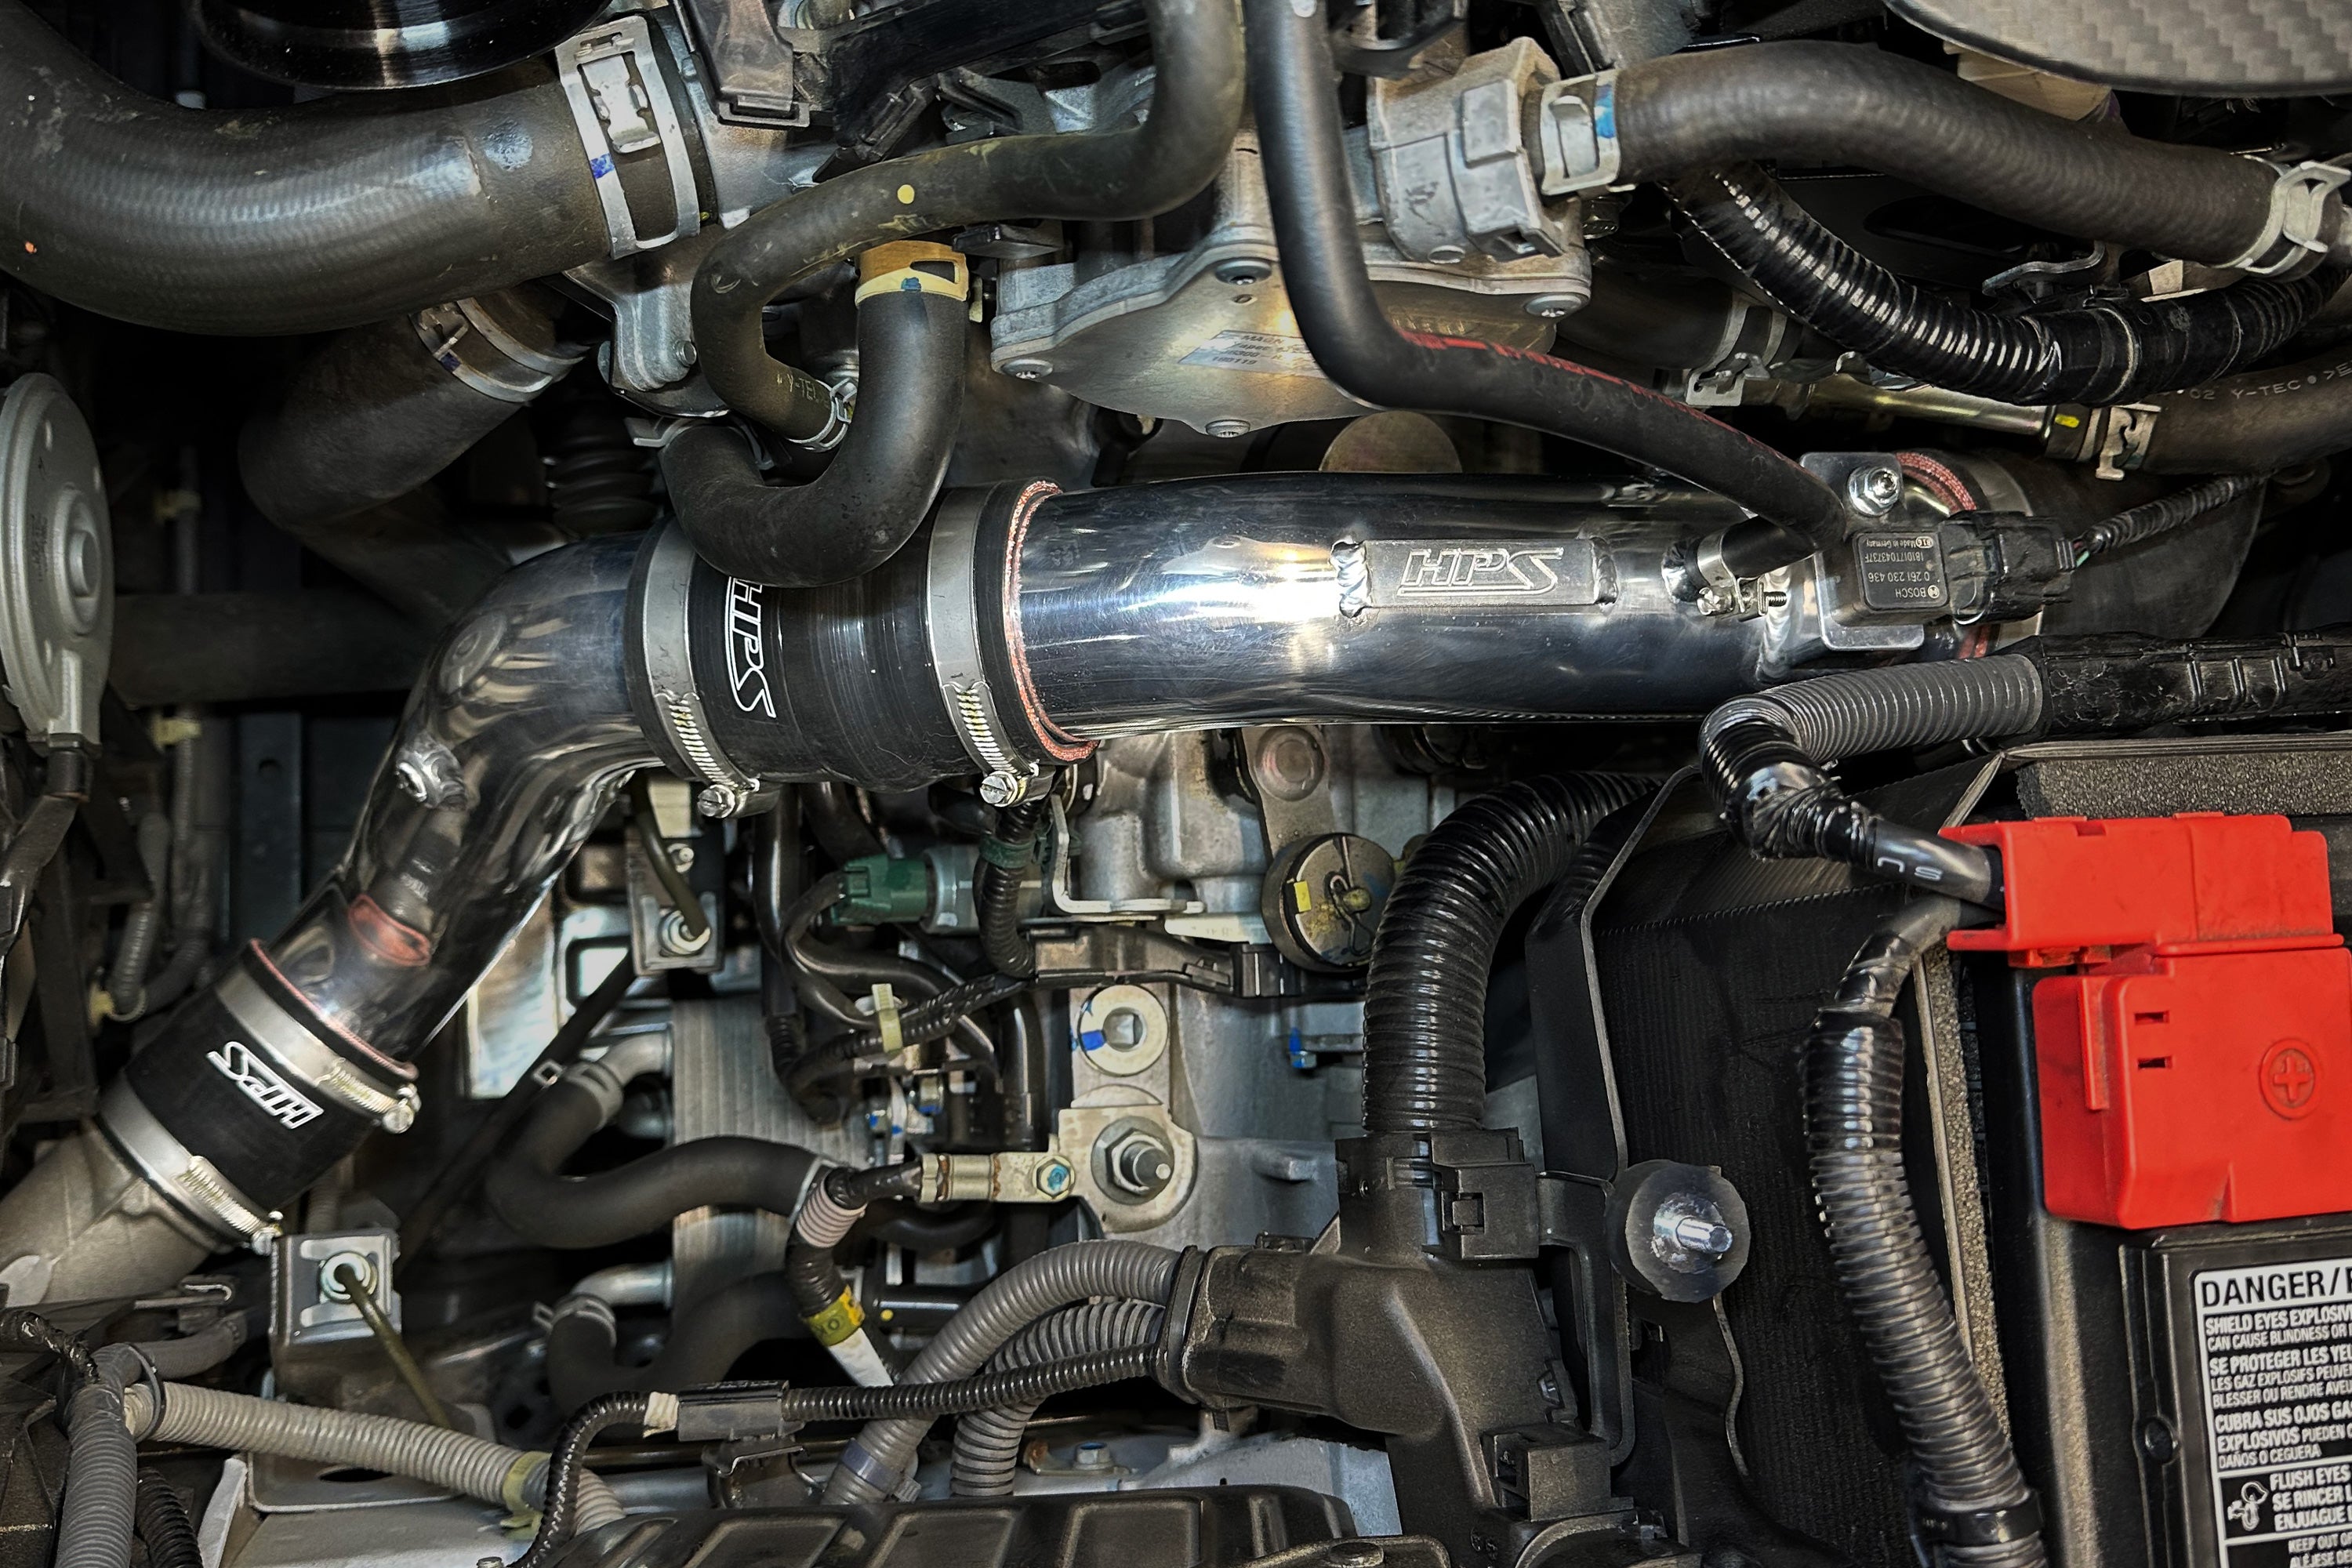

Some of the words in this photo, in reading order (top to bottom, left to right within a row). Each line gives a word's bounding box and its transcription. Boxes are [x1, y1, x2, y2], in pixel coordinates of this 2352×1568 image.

[2231, 379, 2303, 400] Y-TEC
[1866, 539, 1892, 549] Germany
[1396, 546, 1565, 597] HPS
[1867, 572, 1886, 583] 436
[1887, 572, 1905, 583] 230
[1895, 586, 1927, 598] BOSCH
[724, 575, 777, 719] HPS
[205, 1040, 325, 1130] HPS
[2205, 1313, 2254, 1337] SHIELD
[2254, 1309, 2289, 1331] EYES
[2207, 1335, 2232, 1353] CAN
[2232, 1331, 2270, 1350] CAUSE
[2270, 1325, 2330, 1347] BLINDNESS
[2331, 1323, 2347, 1339] OR
[2209, 1356, 2230, 1377] SE
[2230, 1348, 2303, 1374] PROTEGER
[2303, 1345, 2330, 1367] LES
[2211, 1376, 2233, 1392] LES
[2234, 1373, 2256, 1389] GAZ
[2257, 1367, 2315, 1388] EXPLOSIFS
[2316, 1363, 2352, 1381] PEUVE
[2212, 1388, 2263, 1410] BLESSER
[2263, 1387, 2280, 1403] OU
[2280, 1381, 2325, 1401] RENDRE
[2215, 1410, 2264, 1435] CUBRA
[2263, 1406, 2292, 1428] SUS
[2293, 1402, 2331, 1425] OJOS
[2332, 1399, 2352, 1421] GA
[2217, 1425, 2301, 1454] EXPLOSIVOS
[2301, 1423, 2347, 1443] PUEDEN
[2259, 1450, 2269, 1465] O
[2269, 1443, 2322, 1464] CEGUERA
[2270, 1468, 2315, 1492] FLUSH
[2315, 1464, 2352, 1486] EYES
[2272, 1491, 2293, 1512] SE
[2293, 1485, 2344, 1509] RINCER
[2274, 1504, 2347, 1532] ENJUAGUE
[2288, 1537, 2316, 1554] KEEP
[2317, 1534, 2339, 1551] OUT
